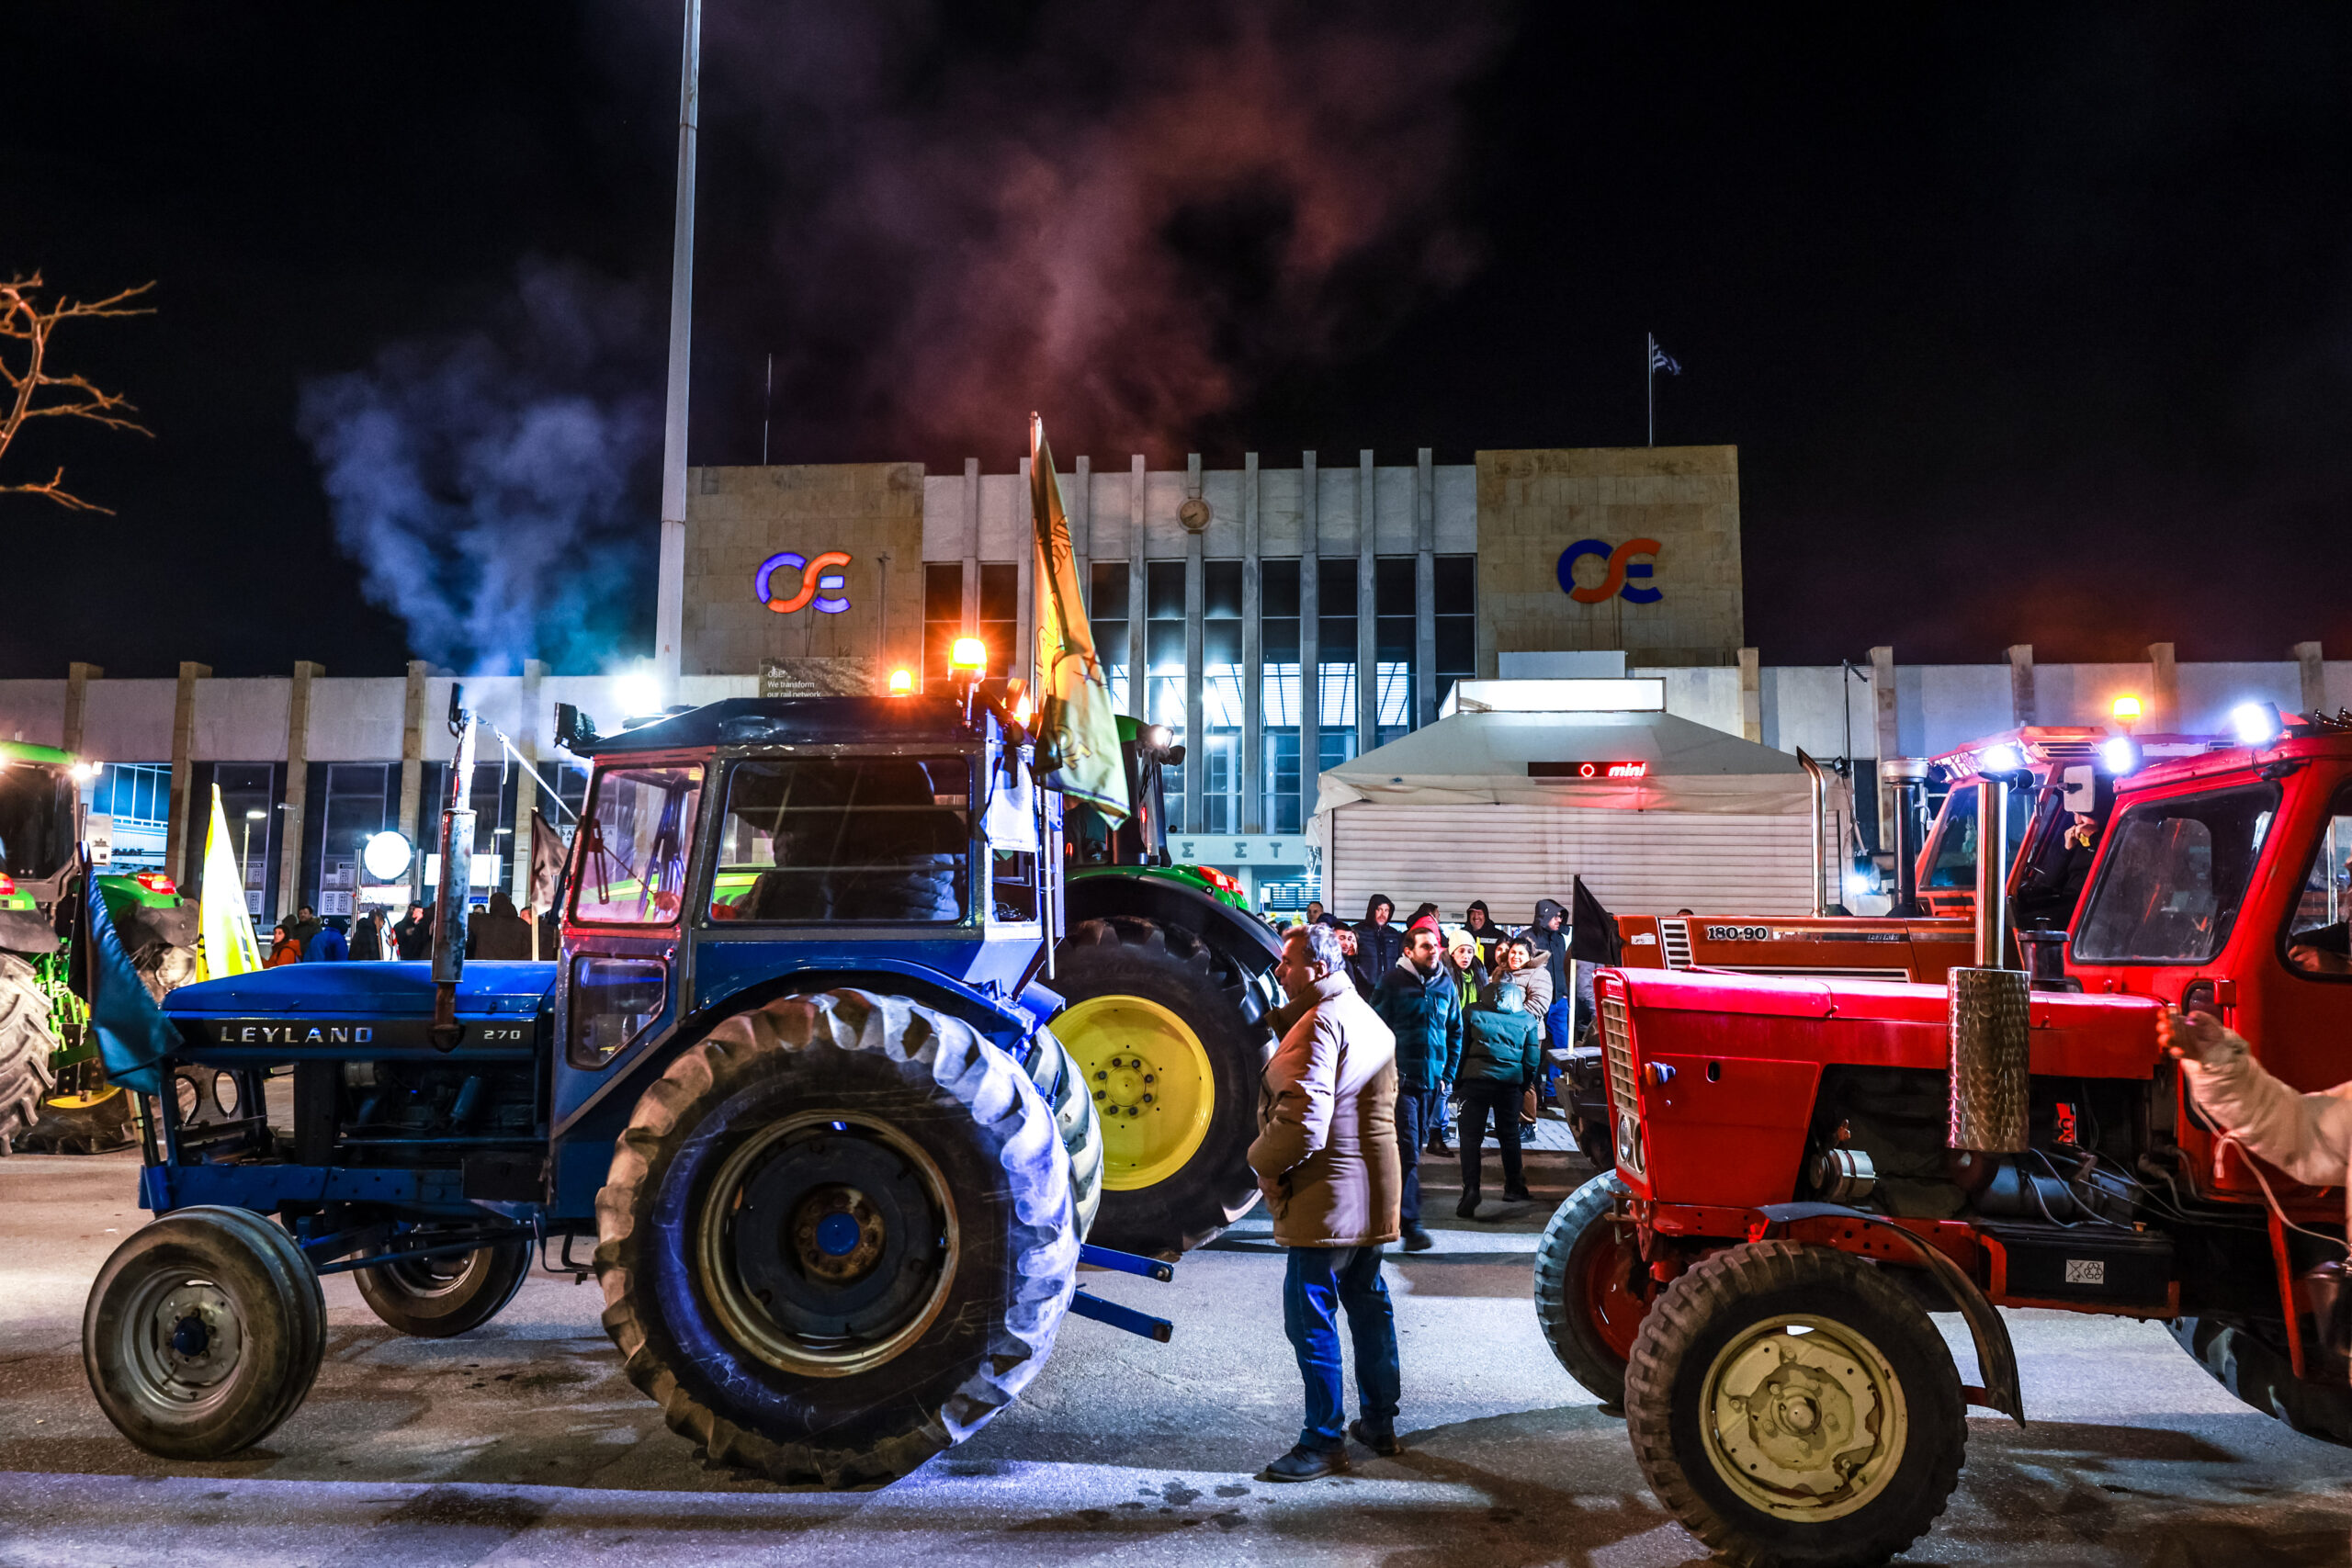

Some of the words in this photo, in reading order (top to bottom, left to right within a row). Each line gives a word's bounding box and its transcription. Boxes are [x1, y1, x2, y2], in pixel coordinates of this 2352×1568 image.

[1608, 762, 1645, 777] mini
[220, 1027, 373, 1043] LEYLAND
[484, 1030, 521, 1041] 270
